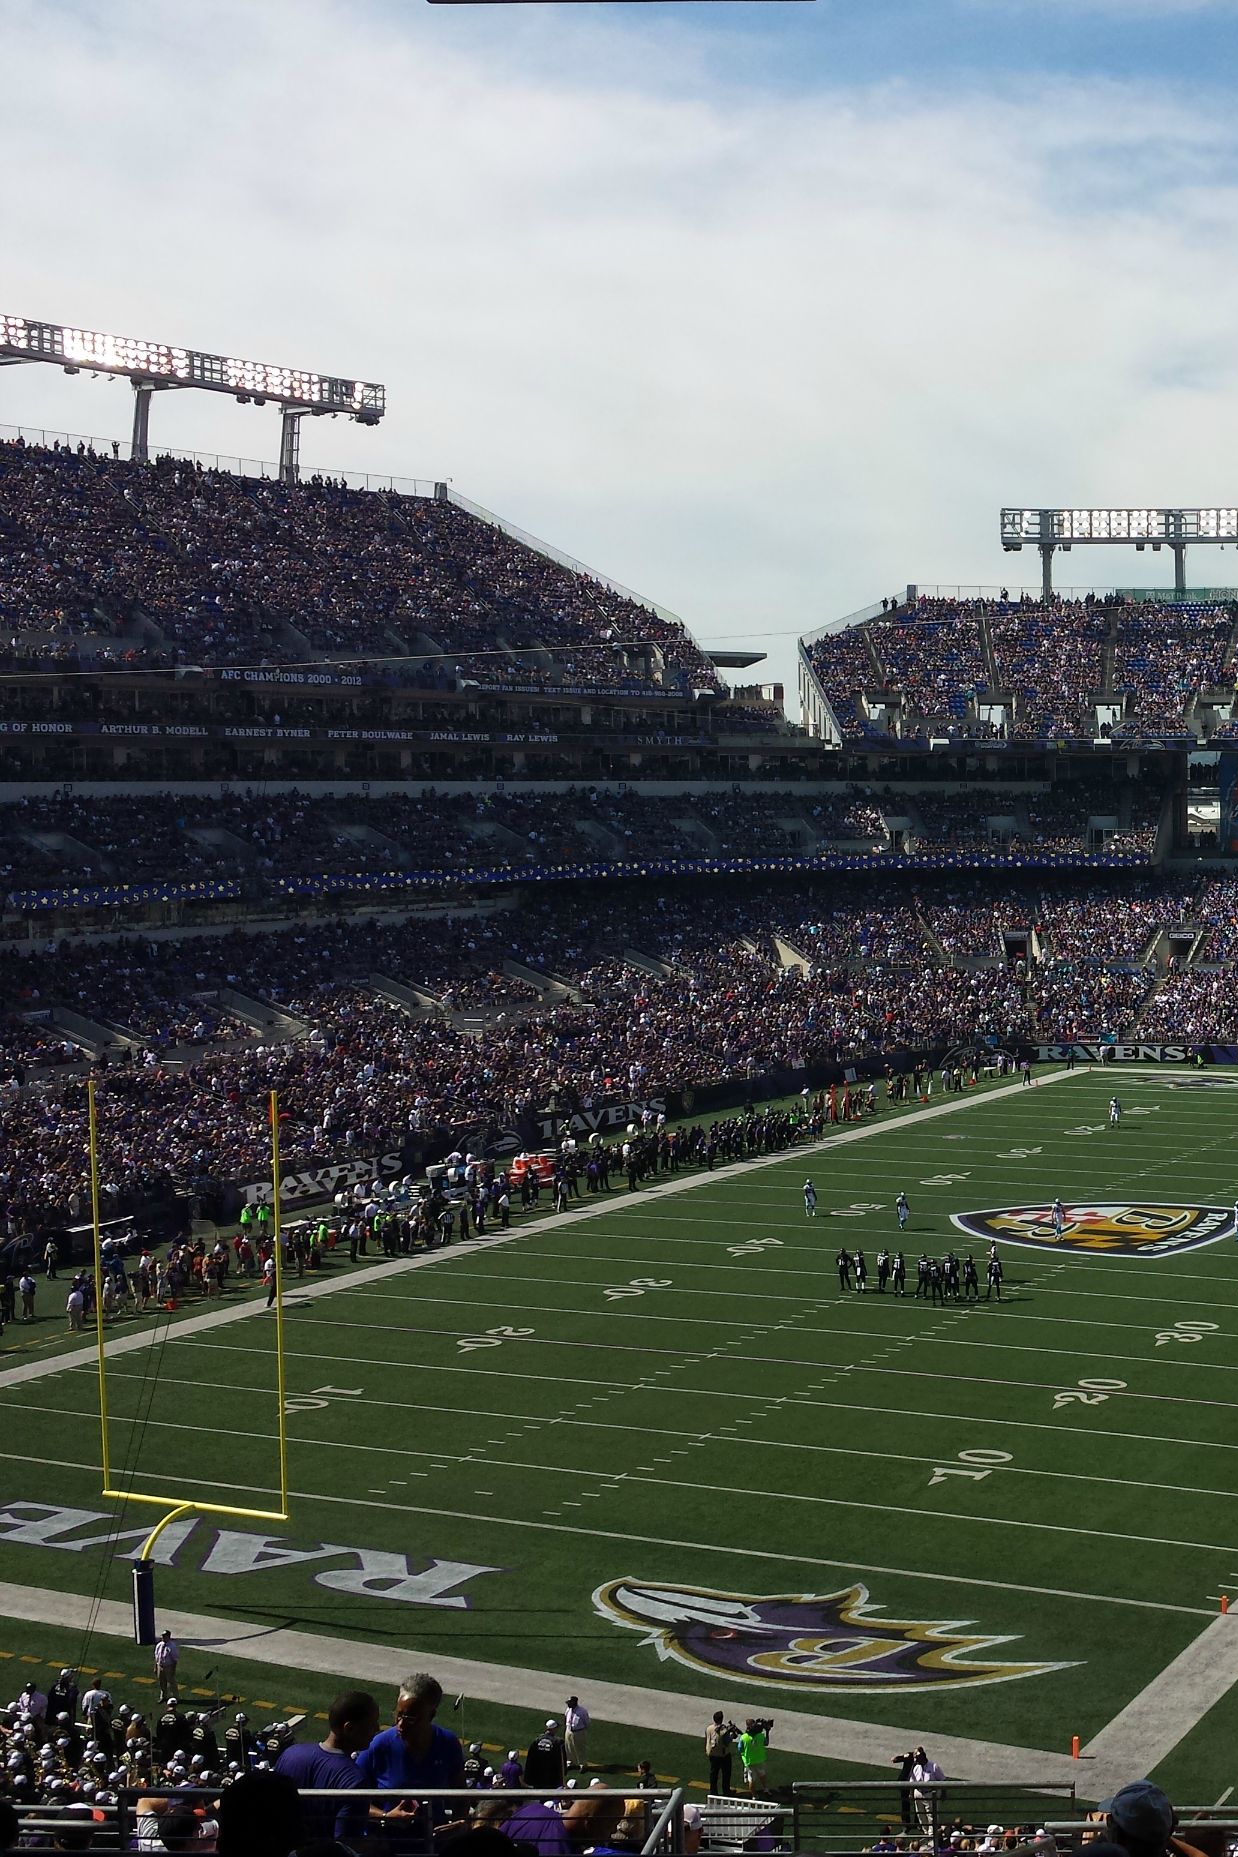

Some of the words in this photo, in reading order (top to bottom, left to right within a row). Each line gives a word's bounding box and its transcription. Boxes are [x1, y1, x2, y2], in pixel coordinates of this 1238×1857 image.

[220, 670, 241, 680] AFC
[244, 670, 304, 683] CHAMPIONS
[307, 673, 331, 684] 2000
[341, 675, 362, 686] 2012
[583, 688, 597, 696] AND
[597, 688, 629, 697] LOCATION
[631, 690, 640, 698] TO
[12, 723, 28, 733] OF
[32, 723, 73, 734] HONOR
[101, 724, 148, 735] ARTHUR
[151, 726, 162, 735] B.
[165, 726, 209, 736] MODELL
[225, 727, 273, 737] EARNEST
[276, 729, 311, 738] BYNER
[328, 730, 359, 739] PETER
[362, 730, 413, 740] BOULWARE
[430, 732, 458, 741] JAMAL
[462, 733, 490, 742] LEWIS
[506, 734, 525, 742] RAY
[528, 735, 558, 743] LEWIS
[636, 736, 683, 745] SMYTH
[1035, 1045, 1189, 1063] RAVENS
[996, 1147, 1042, 1159] 30
[238, 1152, 402, 1205] RAVENS
[920, 1173, 966, 1186] 40
[830, 1203, 889, 1217] 50
[726, 1237, 784, 1253] 40
[603, 1278, 673, 1297] 30
[457, 1325, 535, 1348] 20
[1155, 1321, 1219, 1343] 30
[281, 1385, 364, 1411] 10
[1054, 1378, 1128, 1406] 20
[933, 1449, 1014, 1481] 10
